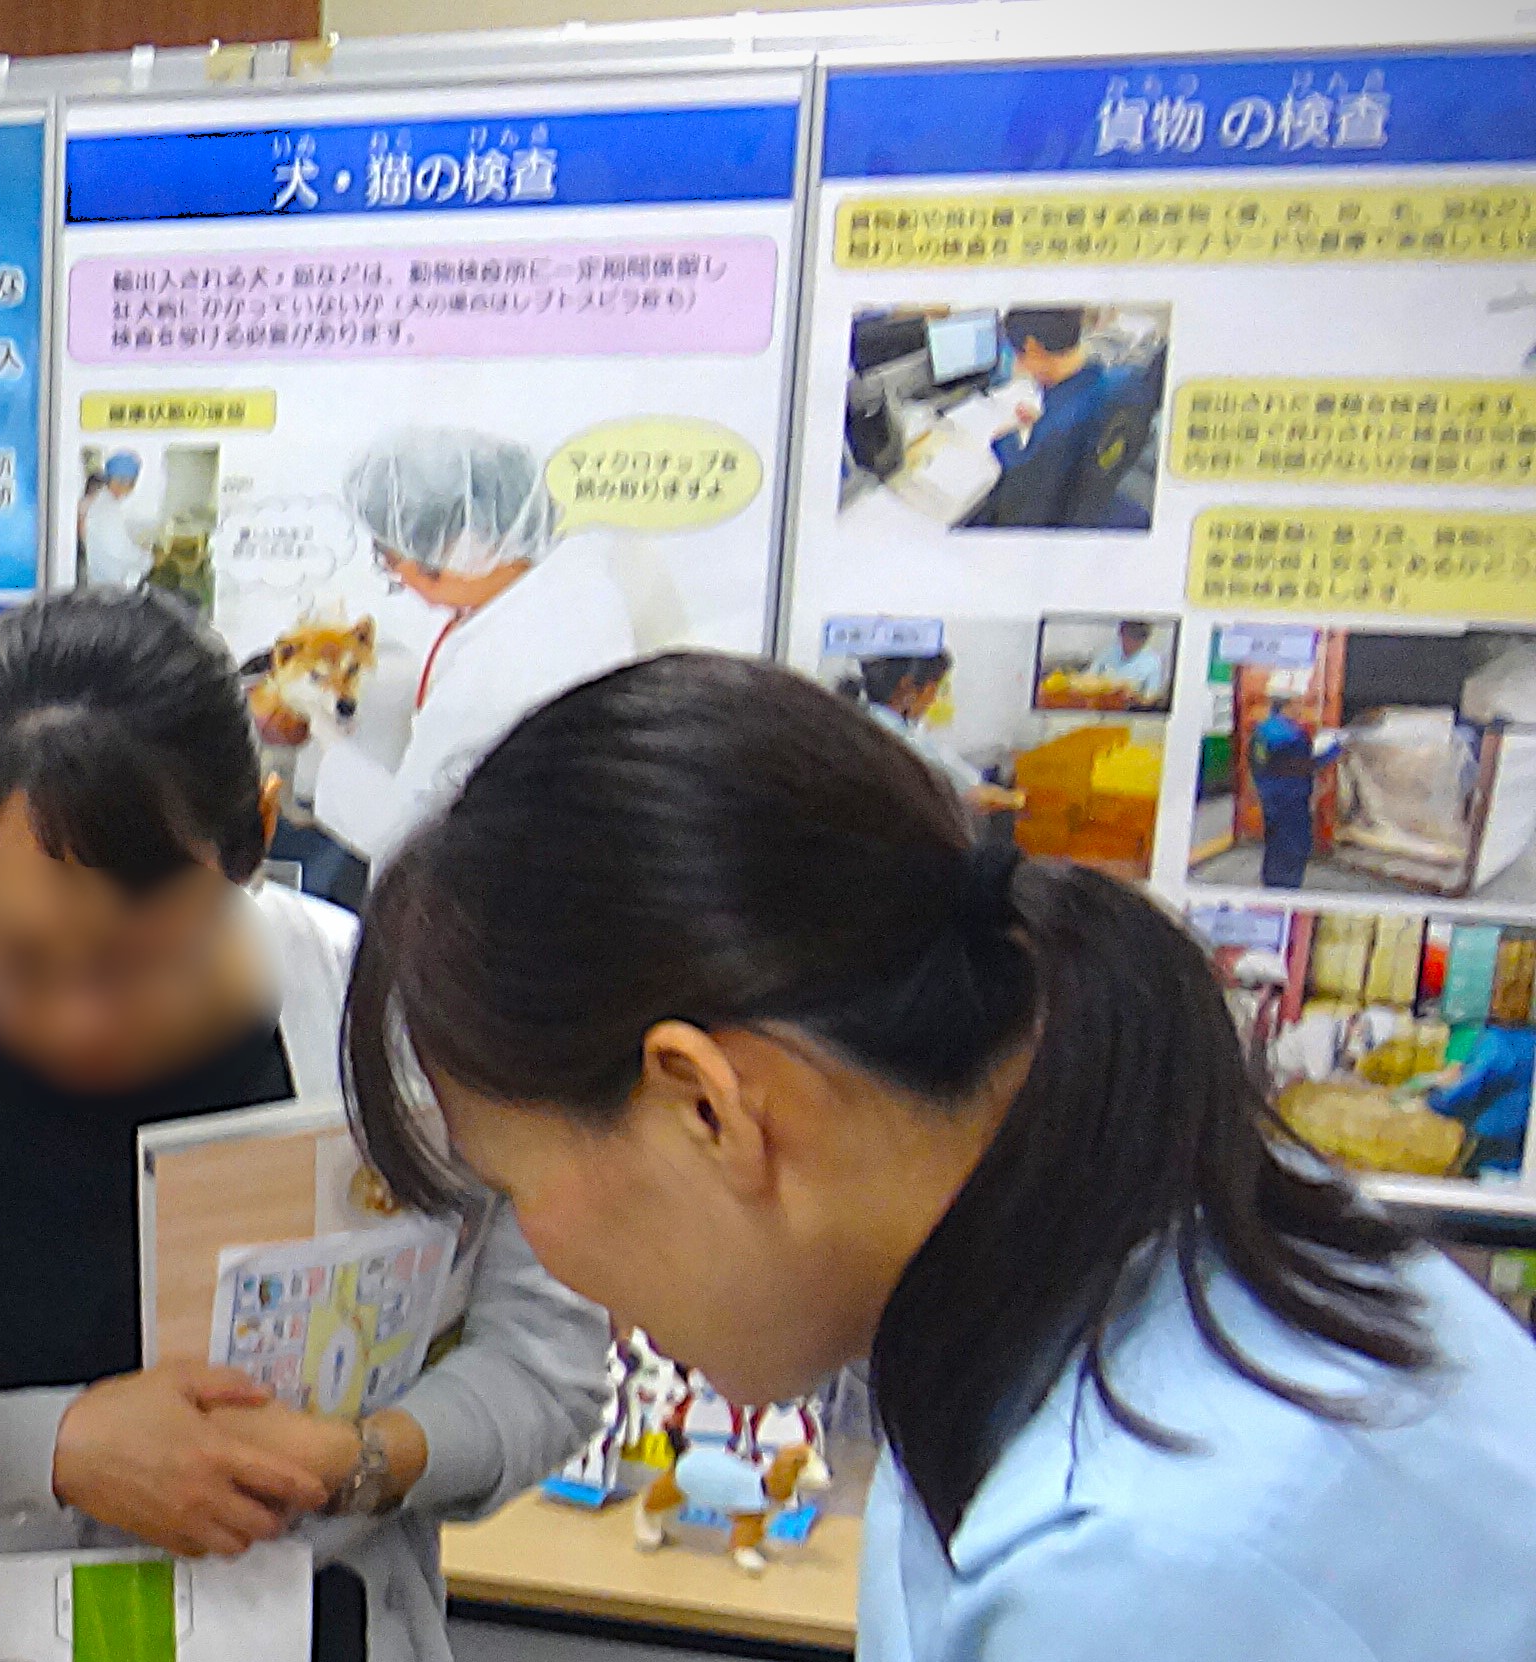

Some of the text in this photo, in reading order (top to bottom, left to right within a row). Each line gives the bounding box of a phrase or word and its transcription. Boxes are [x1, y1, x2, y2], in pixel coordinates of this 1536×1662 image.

[273, 149, 558, 209] 犬・猫の検査
